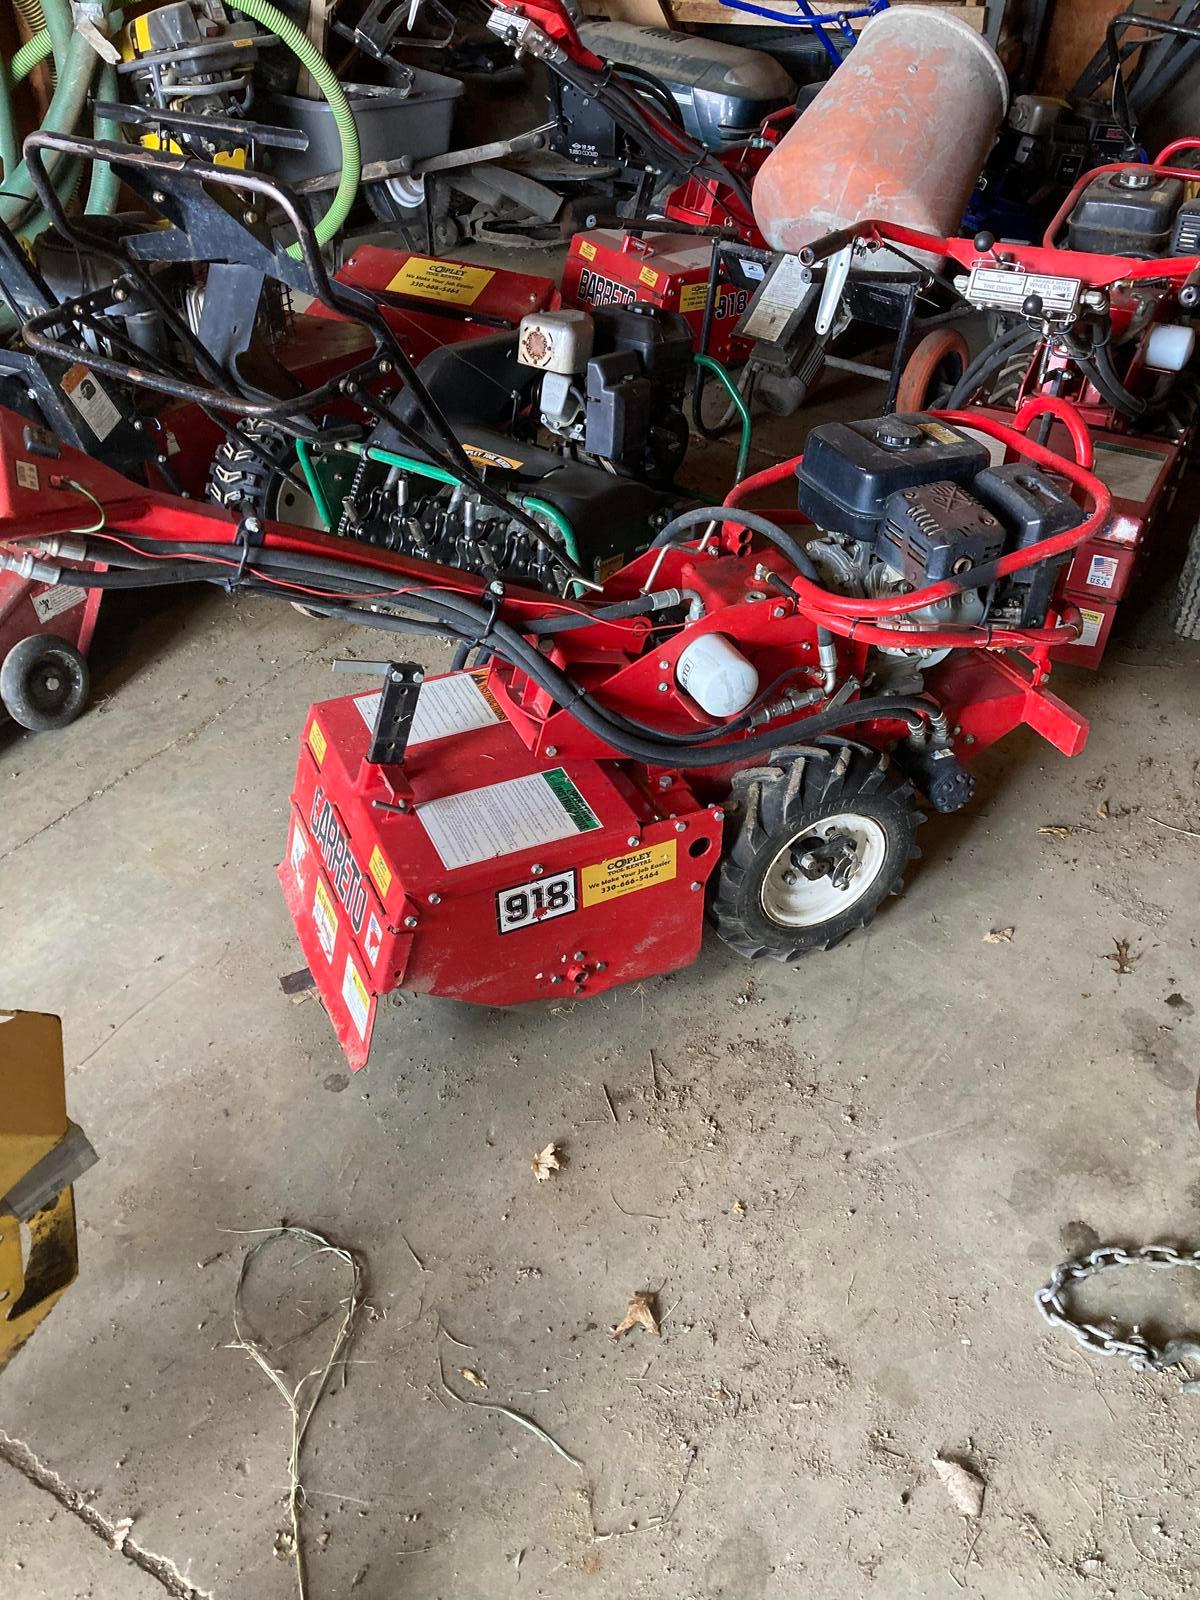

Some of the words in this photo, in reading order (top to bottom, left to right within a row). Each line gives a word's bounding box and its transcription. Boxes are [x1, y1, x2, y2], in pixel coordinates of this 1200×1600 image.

[429, 265, 467, 276] COPLEY
[1029, 282, 1051, 290] WHEEL
[1052, 285, 1072, 293] DRIVE
[714, 289, 749, 320] 918
[552, 785, 589, 831] INSTRUCTIONS
[607, 850, 652, 871] COPLEY
[607, 867, 624, 876] TOOL
[625, 859, 652, 871] RENTAL
[588, 882, 600, 890] We
[601, 876, 619, 886] Make
[621, 871, 636, 879] Your
[638, 866, 649, 875] Job
[650, 860, 671, 869] Easier
[601, 871, 659, 893] 330-666-5464
[503, 878, 572, 925] 918
